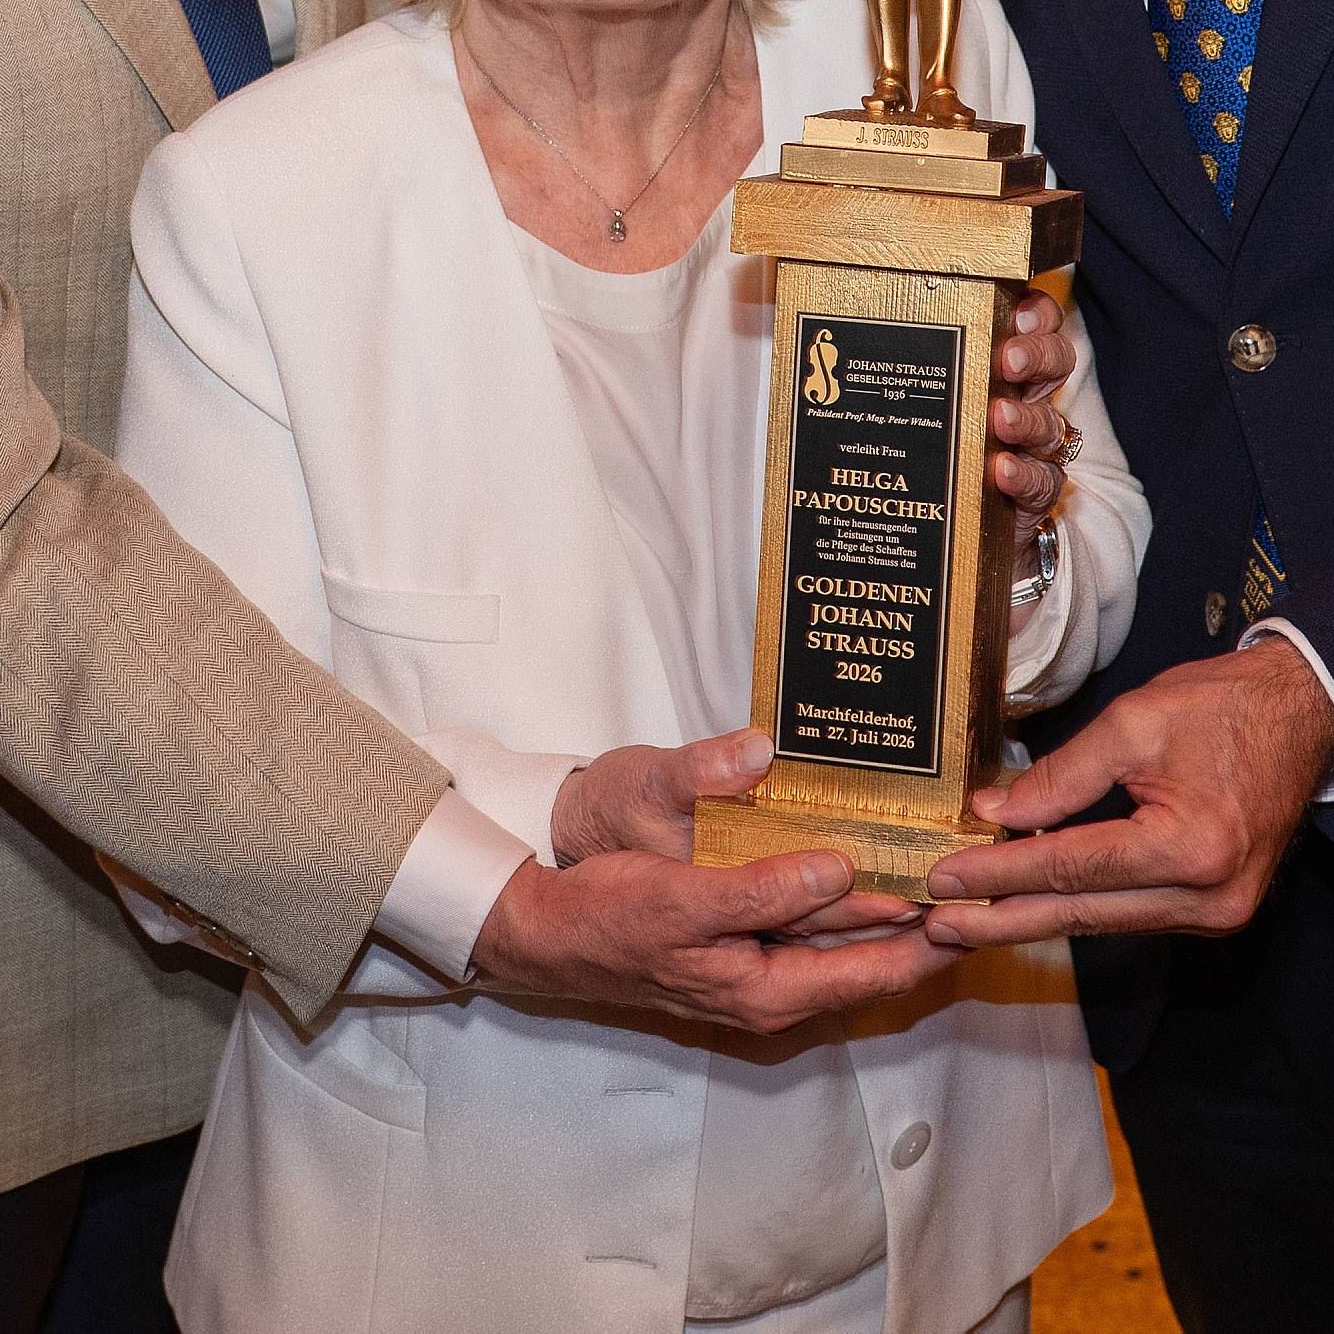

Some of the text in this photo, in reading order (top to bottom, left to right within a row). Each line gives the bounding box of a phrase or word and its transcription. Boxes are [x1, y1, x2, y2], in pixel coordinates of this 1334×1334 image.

[856, 127, 929, 149] J. STRAUSS
[847, 360, 947, 377] JOHANN STRAUSS
[846, 373, 946, 390] GESELLSCHAFT WIEN
[884, 389, 906, 400] 1936
[807, 408, 844, 419] Präsident
[845, 412, 865, 421] Prof.
[866, 414, 886, 425] Mag.
[889, 417, 909, 425] Peter
[840, 444, 906, 458] verleiht Frau
[831, 468, 909, 491] HELGA
[793, 490, 945, 521] PAPOUSCHEK
[819, 515, 917, 534] für ihre herausragenden
[837, 529, 899, 543] Leistungen um
[817, 539, 917, 557] die Pflege des Schaffens
[818, 552, 916, 569] von Johann Strauss den
[797, 575, 932, 606] GOLDENEN
[811, 604, 914, 631] JOHANN
[807, 631, 915, 659] STRAUSS
[836, 662, 883, 683] 2026
[797, 703, 917, 731] Marchfelderhof,
[798, 726, 915, 749] am 27. Juli 2026
